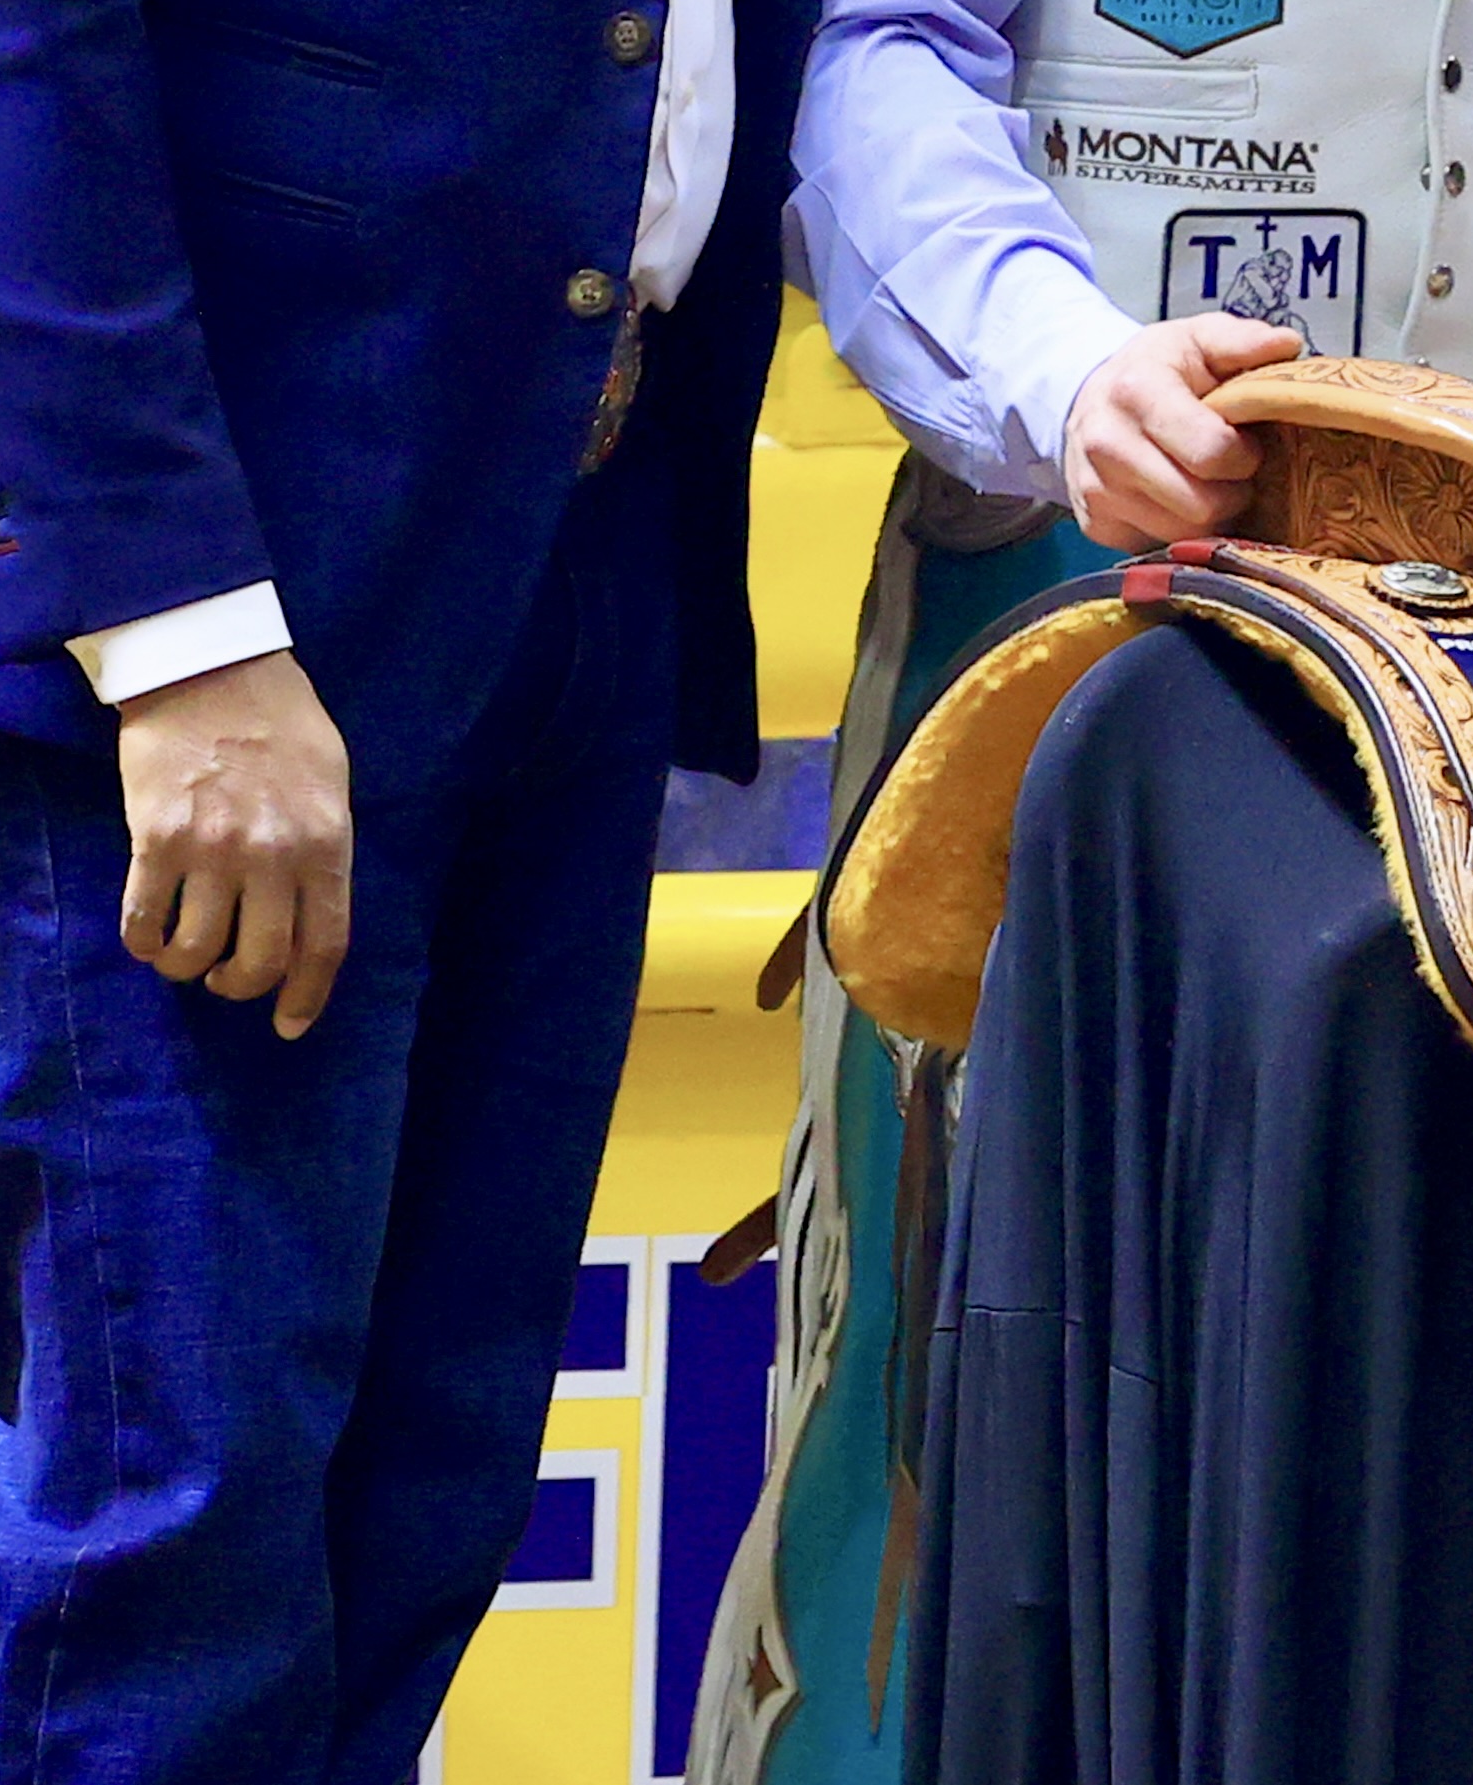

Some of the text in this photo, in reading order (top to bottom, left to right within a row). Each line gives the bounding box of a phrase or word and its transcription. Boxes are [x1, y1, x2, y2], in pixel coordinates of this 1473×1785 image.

[1077, 126, 1315, 173] MONTANA
[1075, 165, 1317, 195] SILVERSMITHS
[1188, 234, 1341, 299] T M
